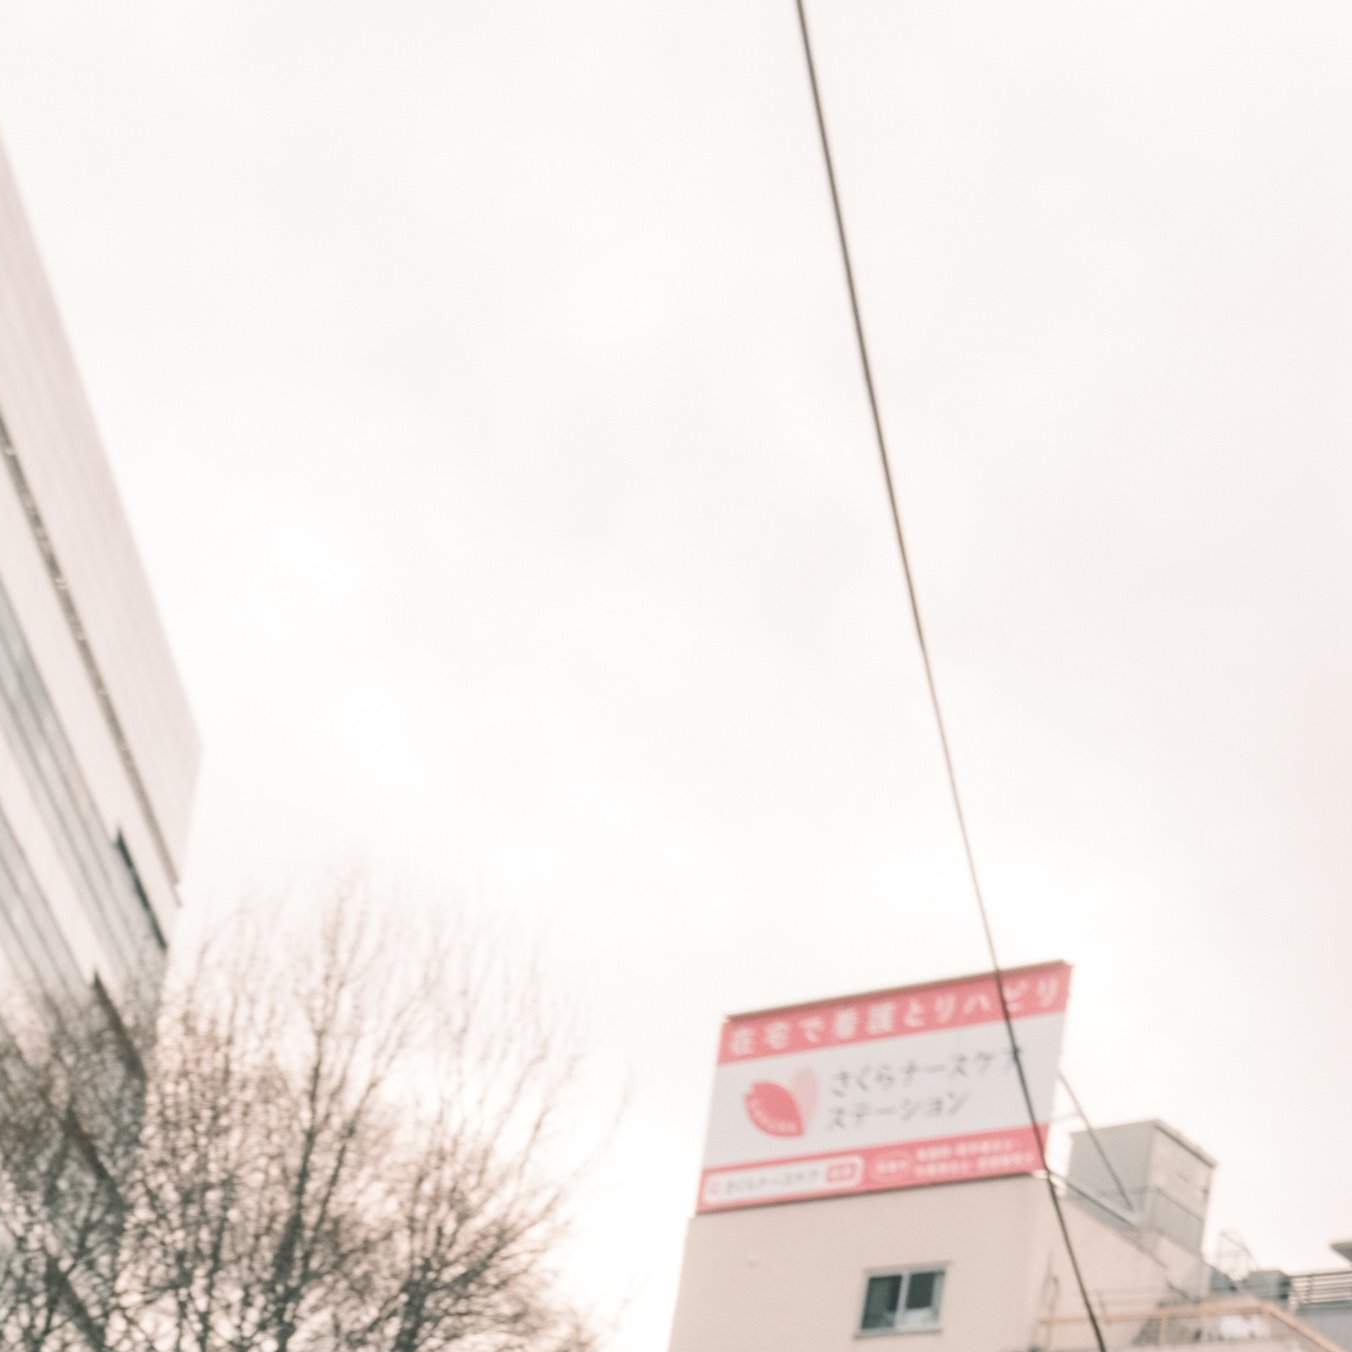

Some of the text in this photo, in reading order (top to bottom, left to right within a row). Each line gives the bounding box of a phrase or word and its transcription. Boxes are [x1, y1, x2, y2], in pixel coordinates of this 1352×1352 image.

[729, 976, 1060, 1055] 在宅で看護とリハビリ
[827, 1091, 970, 1130] ステーション
